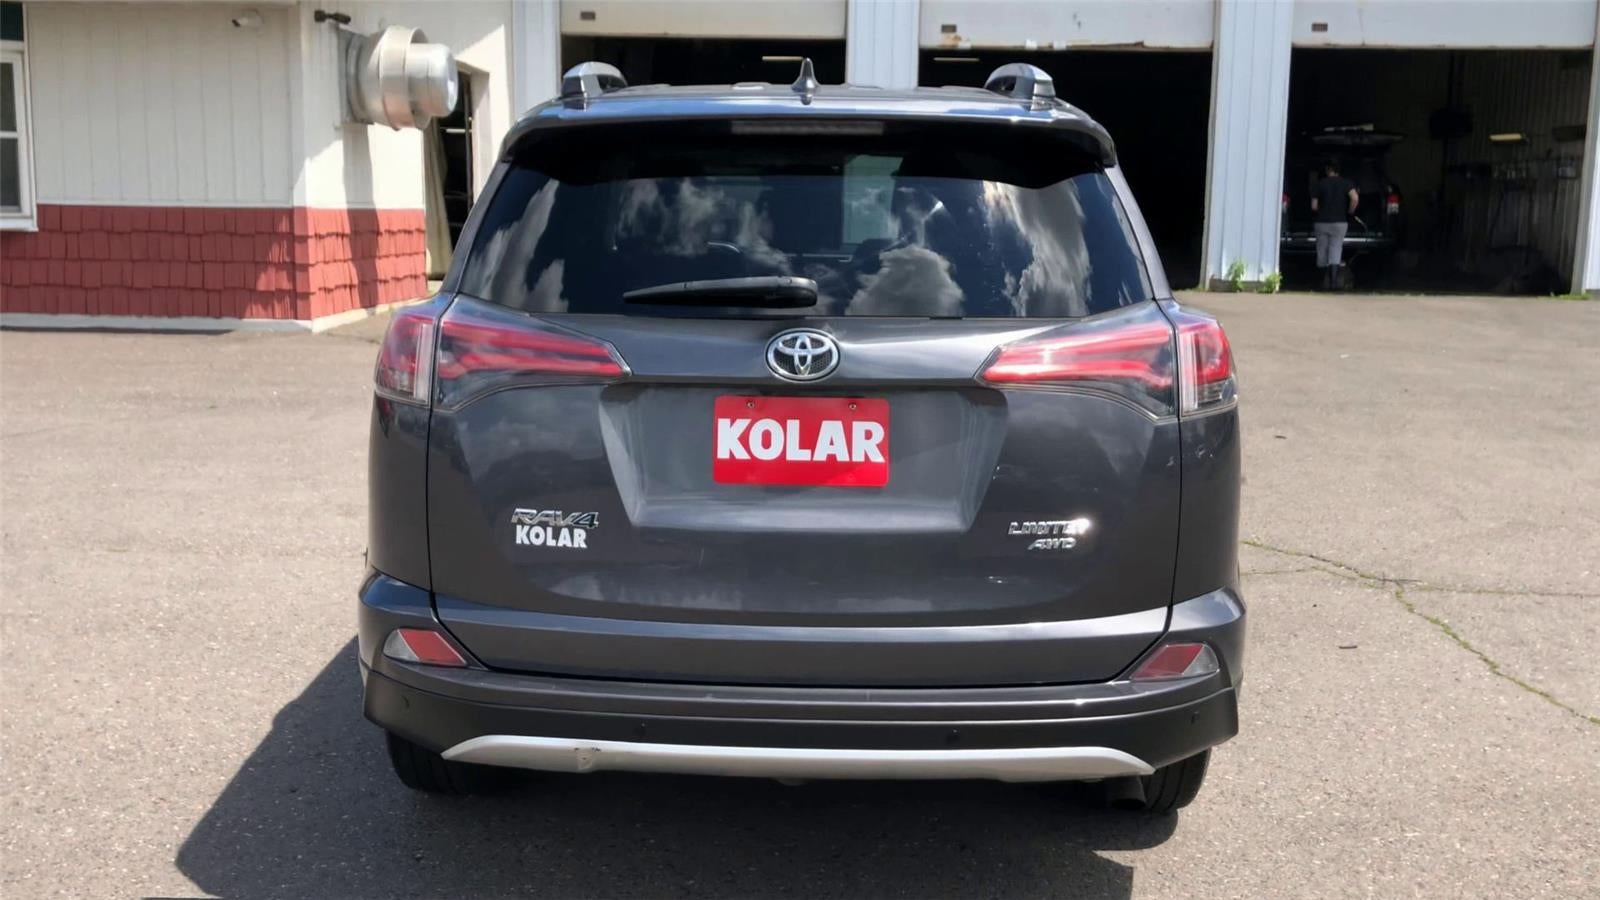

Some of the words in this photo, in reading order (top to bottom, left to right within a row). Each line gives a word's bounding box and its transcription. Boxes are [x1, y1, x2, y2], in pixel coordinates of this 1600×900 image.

[716, 418, 886, 463] KOLAR
[511, 508, 599, 529] RAV4
[1008, 519, 1090, 535] LIMITE
[515, 525, 588, 548] KOLAR
[1027, 537, 1077, 551] AWD
